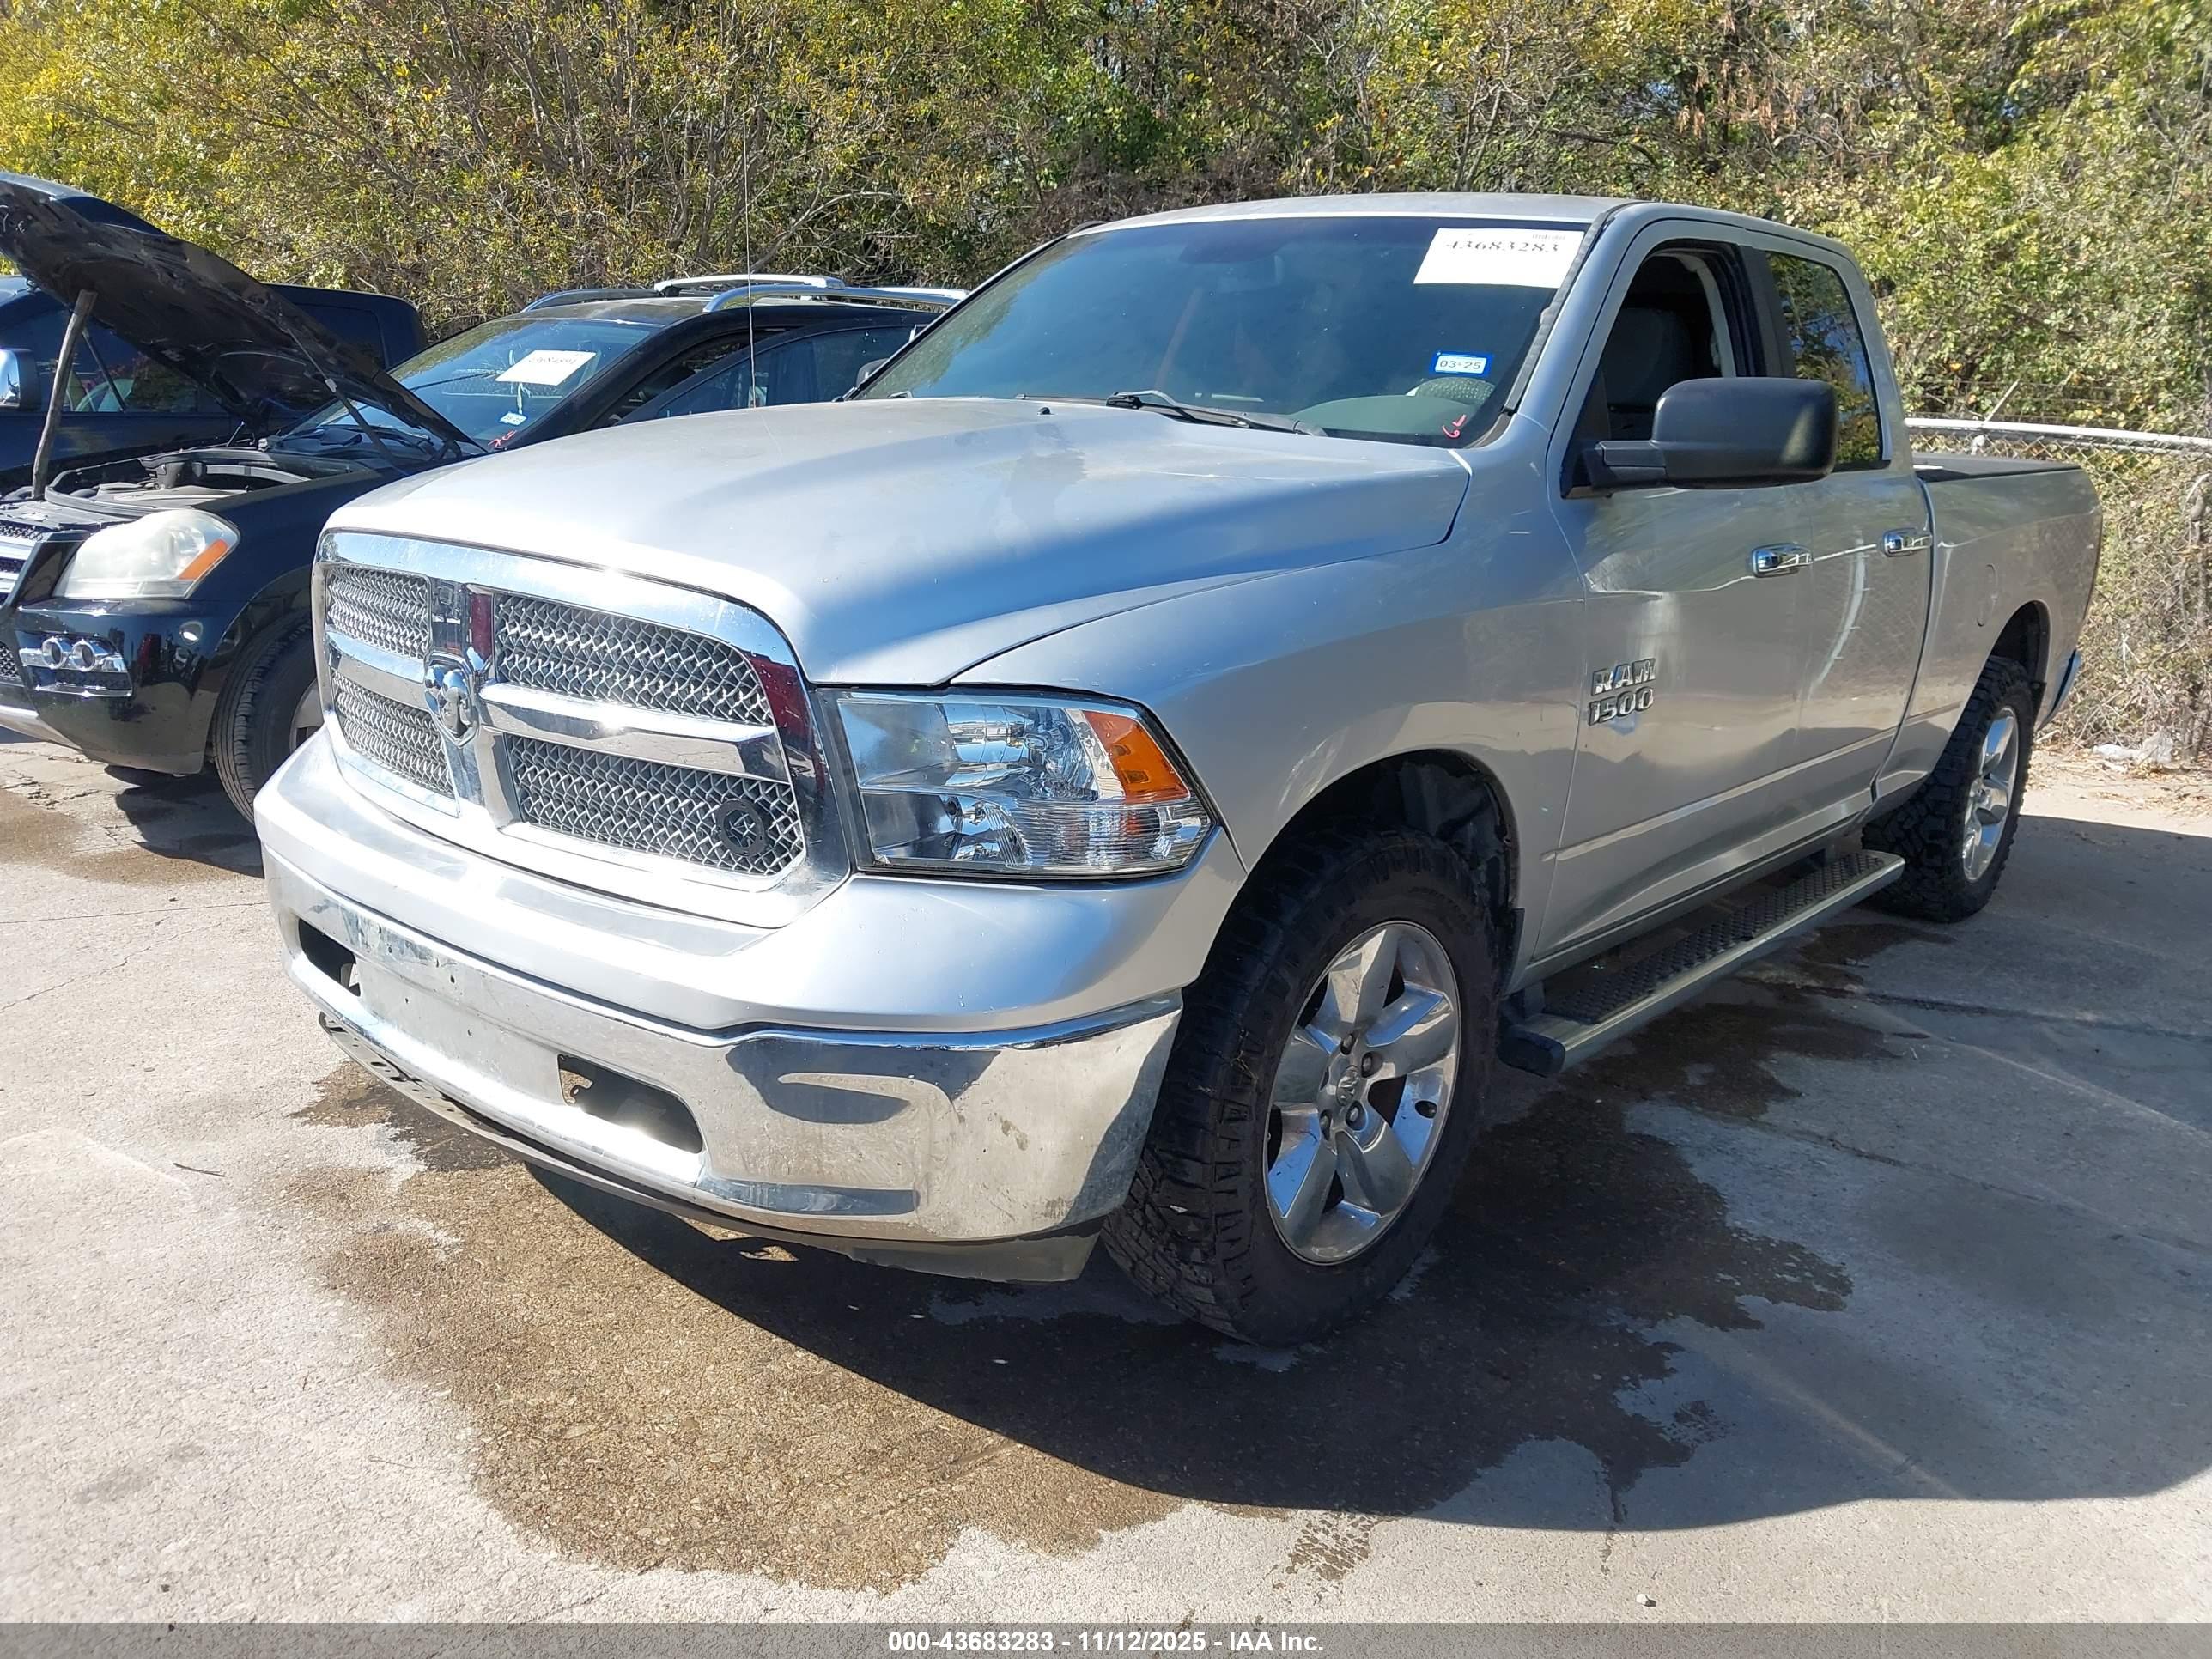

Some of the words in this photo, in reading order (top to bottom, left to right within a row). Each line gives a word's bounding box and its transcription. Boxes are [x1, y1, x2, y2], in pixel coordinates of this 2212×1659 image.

[1446, 240, 1559, 252] 43683283
[1591, 658, 1656, 696] RAM
[1588, 686, 1654, 726] 1500
